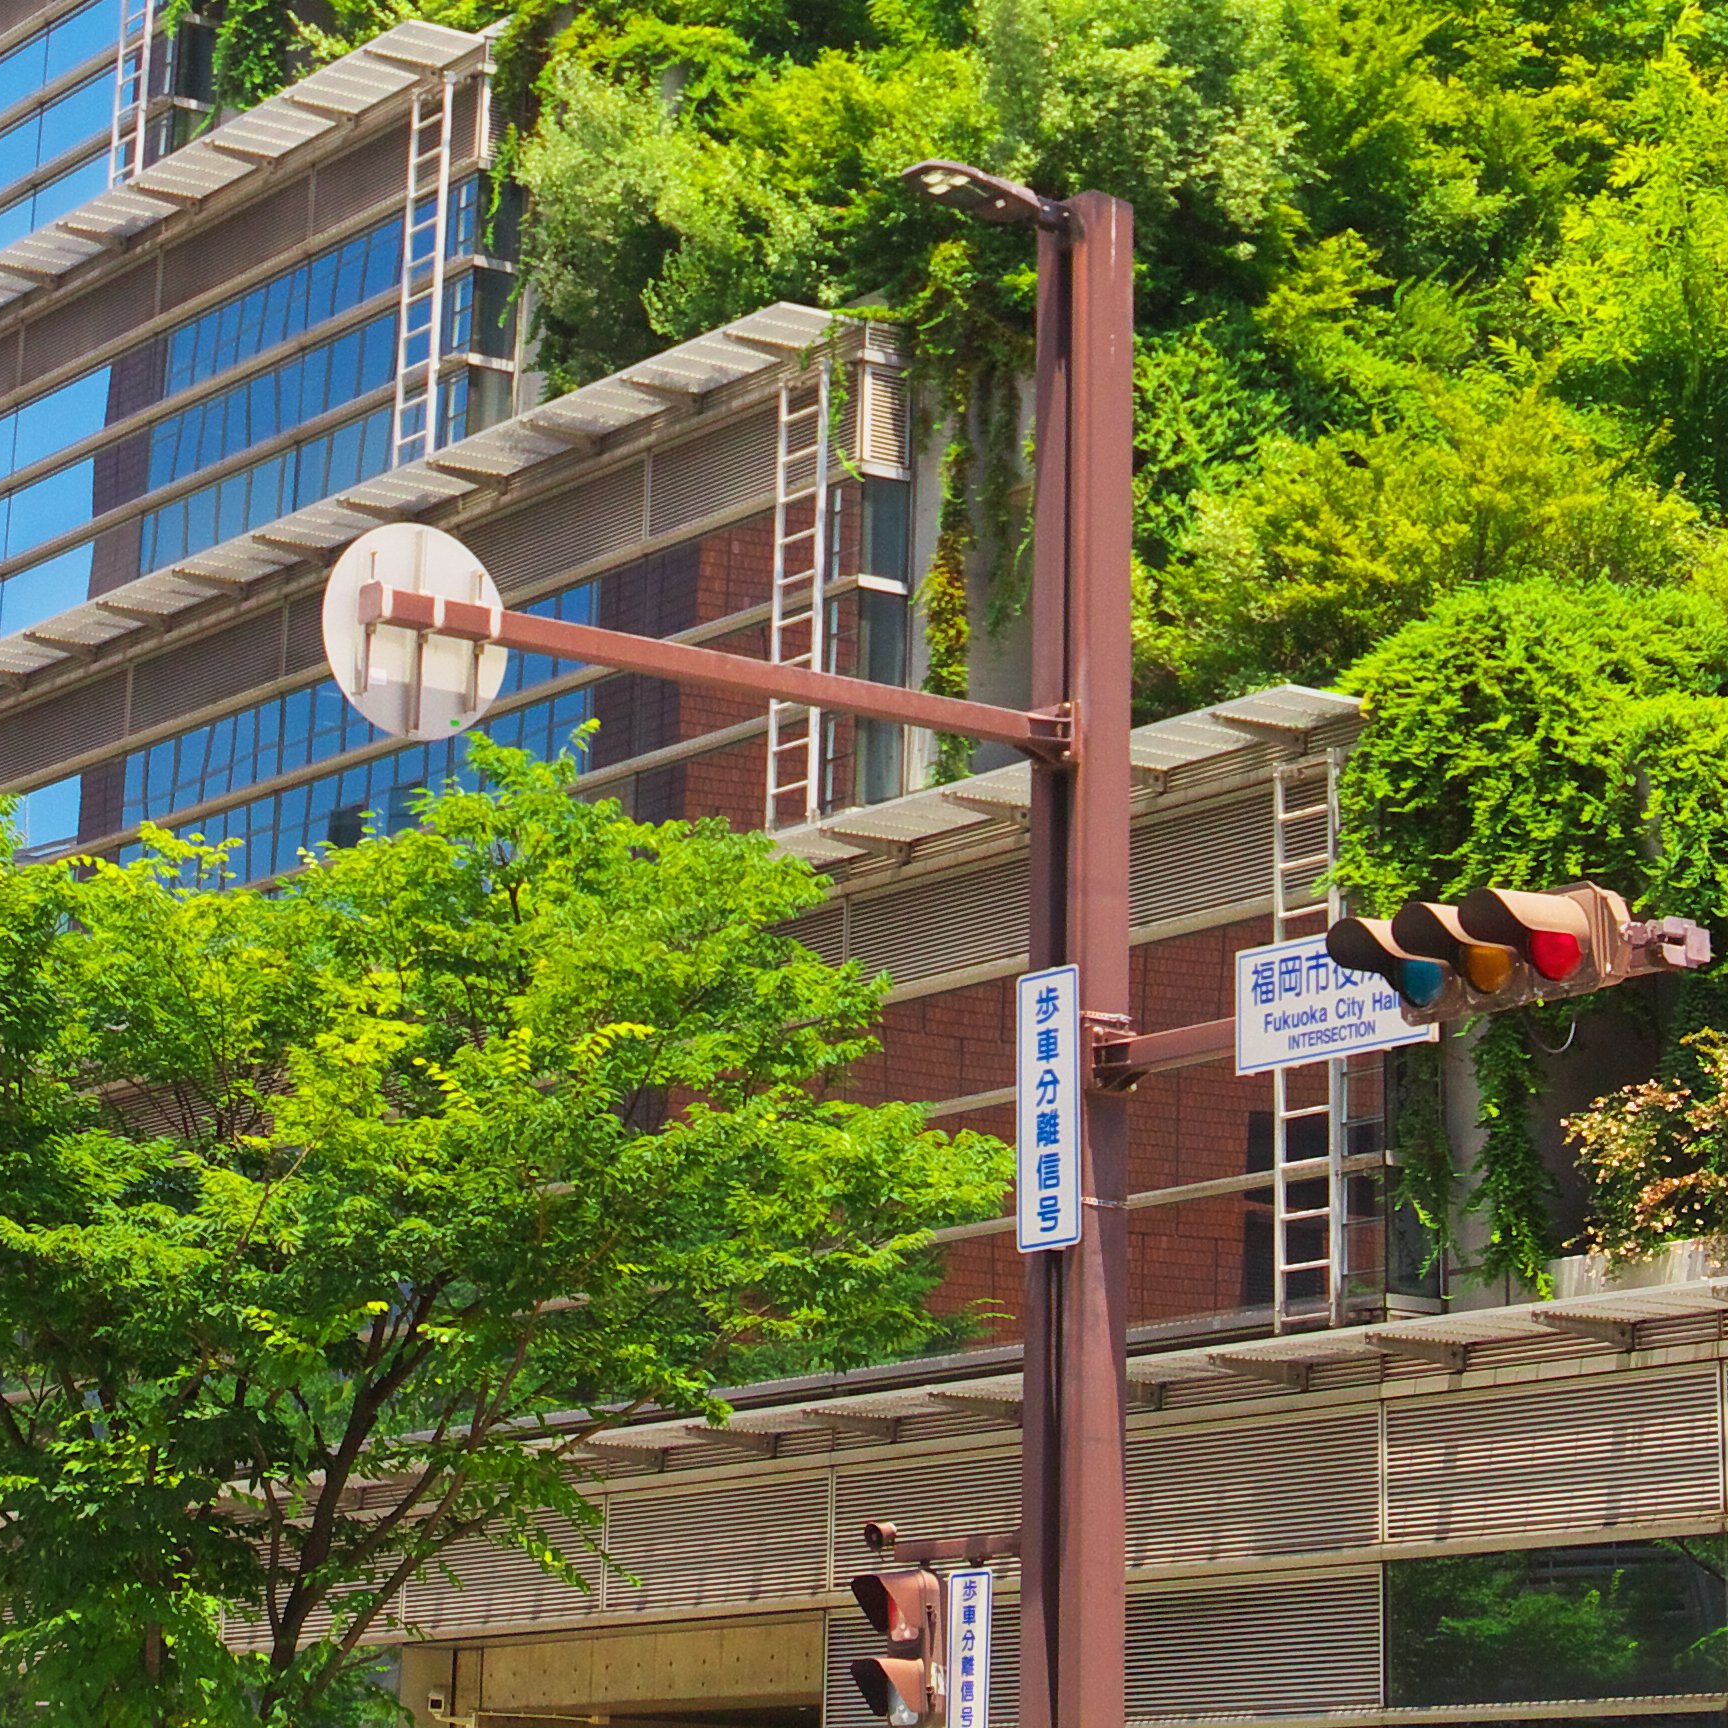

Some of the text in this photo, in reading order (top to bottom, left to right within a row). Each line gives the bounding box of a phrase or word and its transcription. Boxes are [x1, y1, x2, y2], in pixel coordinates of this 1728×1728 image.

[1264, 991, 1402, 1033] Fukuoka City Hall
[1288, 1020, 1376, 1051] INTERSECTION
[1036, 986, 1061, 1232] 歩車分離信号
[960, 1579, 977, 1727] 歩車分離信号
